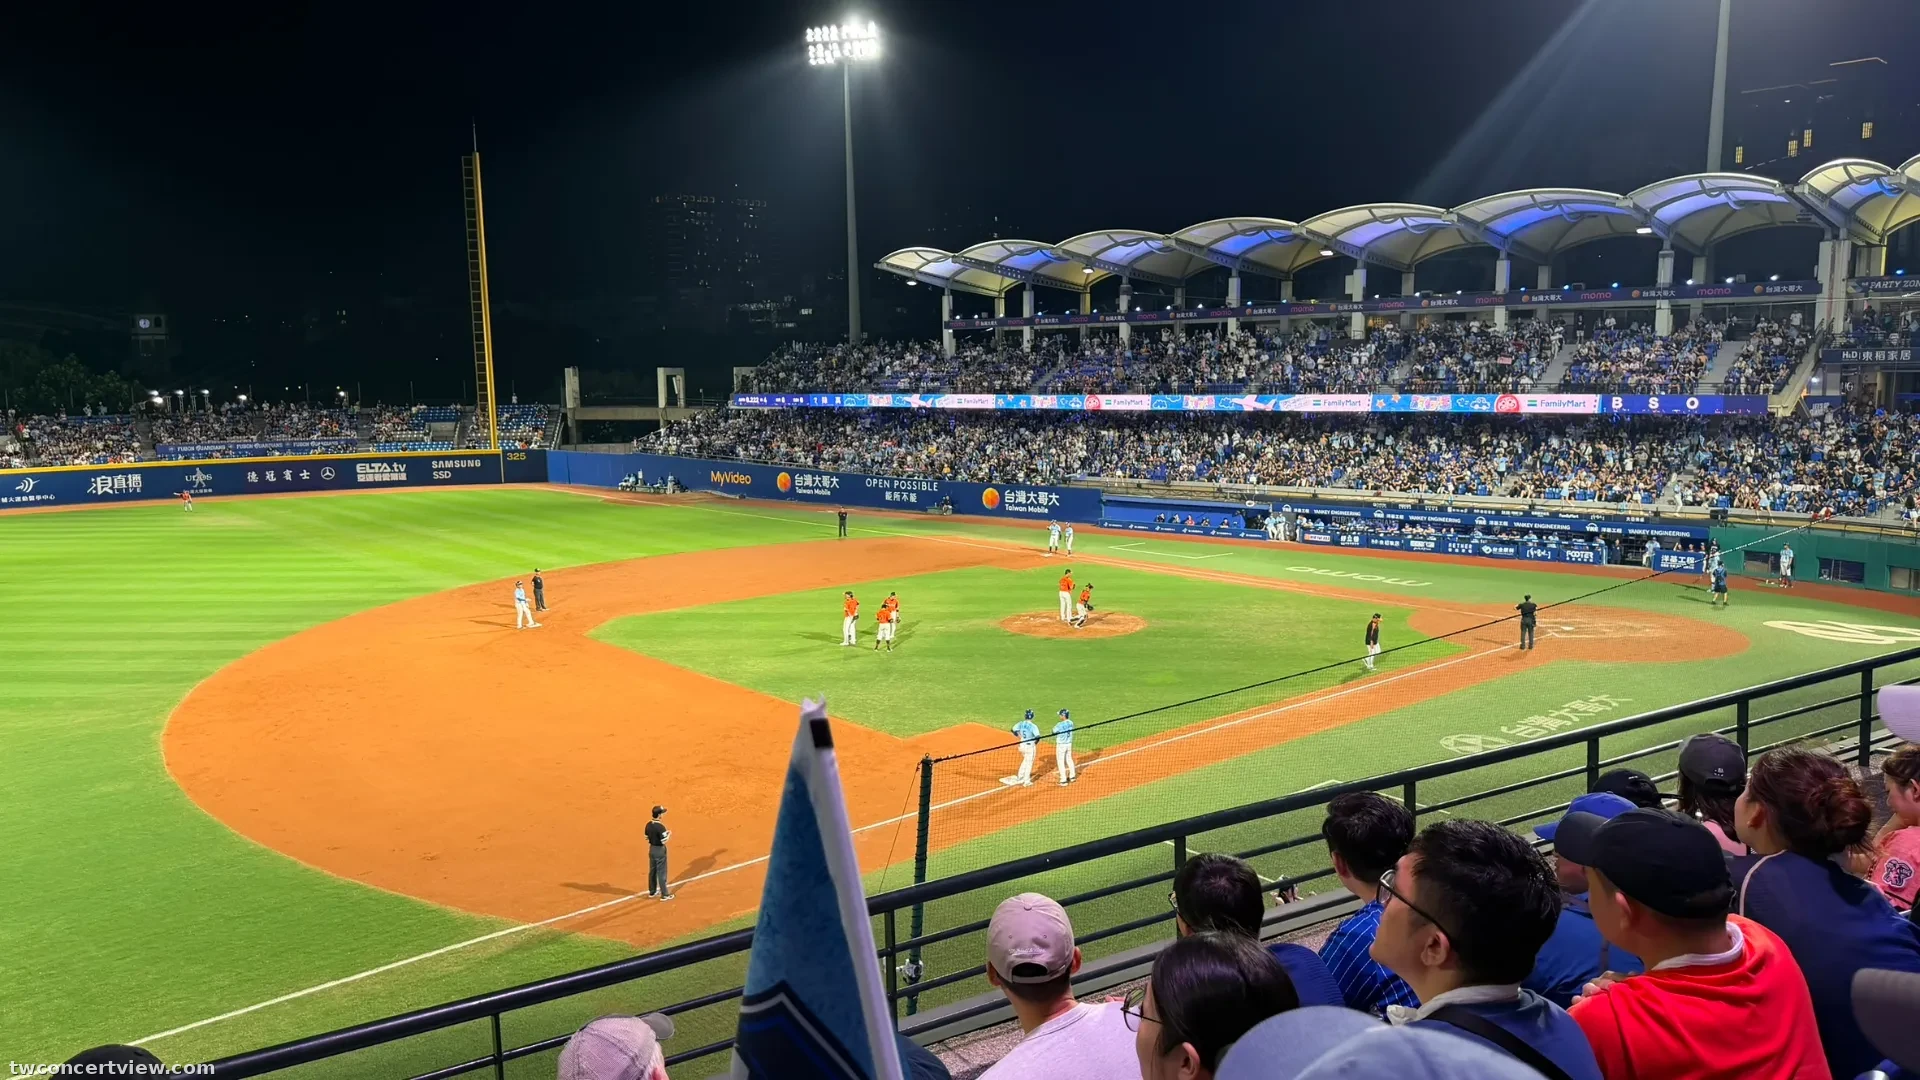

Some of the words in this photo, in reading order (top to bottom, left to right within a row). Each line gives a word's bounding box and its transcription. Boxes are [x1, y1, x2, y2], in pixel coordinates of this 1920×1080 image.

[1765, 285, 1803, 294] 台灣大哥大
[1870, 280, 1900, 289] PARTY
[1581, 291, 1612, 300] momo
[1642, 289, 1676, 297] 台灣大哥大
[1697, 287, 1732, 296] momo
[1475, 296, 1504, 304] momo
[1531, 294, 1562, 302] 台灣大哥大
[1290, 305, 1315, 313] momo
[1378, 301, 1405, 309] momo
[1113, 399, 1143, 407] FamilyMart
[1323, 398, 1361, 408] FamilyMart
[1540, 399, 1586, 409] FamilyMart
[1612, 397, 1623, 409] B
[1648, 397, 1659, 409] S
[1686, 397, 1699, 410] O
[506, 452, 527, 461] 325
[356, 462, 407, 473] ELTA.tv
[431, 459, 482, 469] SAMSUNG
[247, 469, 311, 483] 德冠賓士
[432, 471, 452, 479] SSD
[710, 470, 752, 487] MyVideo
[87, 473, 142, 495] 浪直播
[794, 473, 840, 489] 台灣大哥大
[865, 478, 892, 490] OPEN
[894, 480, 938, 492] POSSIBLE
[795, 486, 814, 495] Taiwan
[814, 488, 832, 496] Mobile
[885, 491, 917, 503] 能所不能
[1004, 489, 1060, 506] 台灣大哥大
[1005, 503, 1027, 512] Taiwan
[1028, 504, 1049, 514] Mobile
[1650, 529, 1691, 537] ENGINEERING
[1566, 550, 1594, 559] FOOTER
[1661, 555, 1695, 563] 洋基工程
[1285, 566, 1433, 587] momo
[1500, 694, 1633, 738] 台灣大哥大
